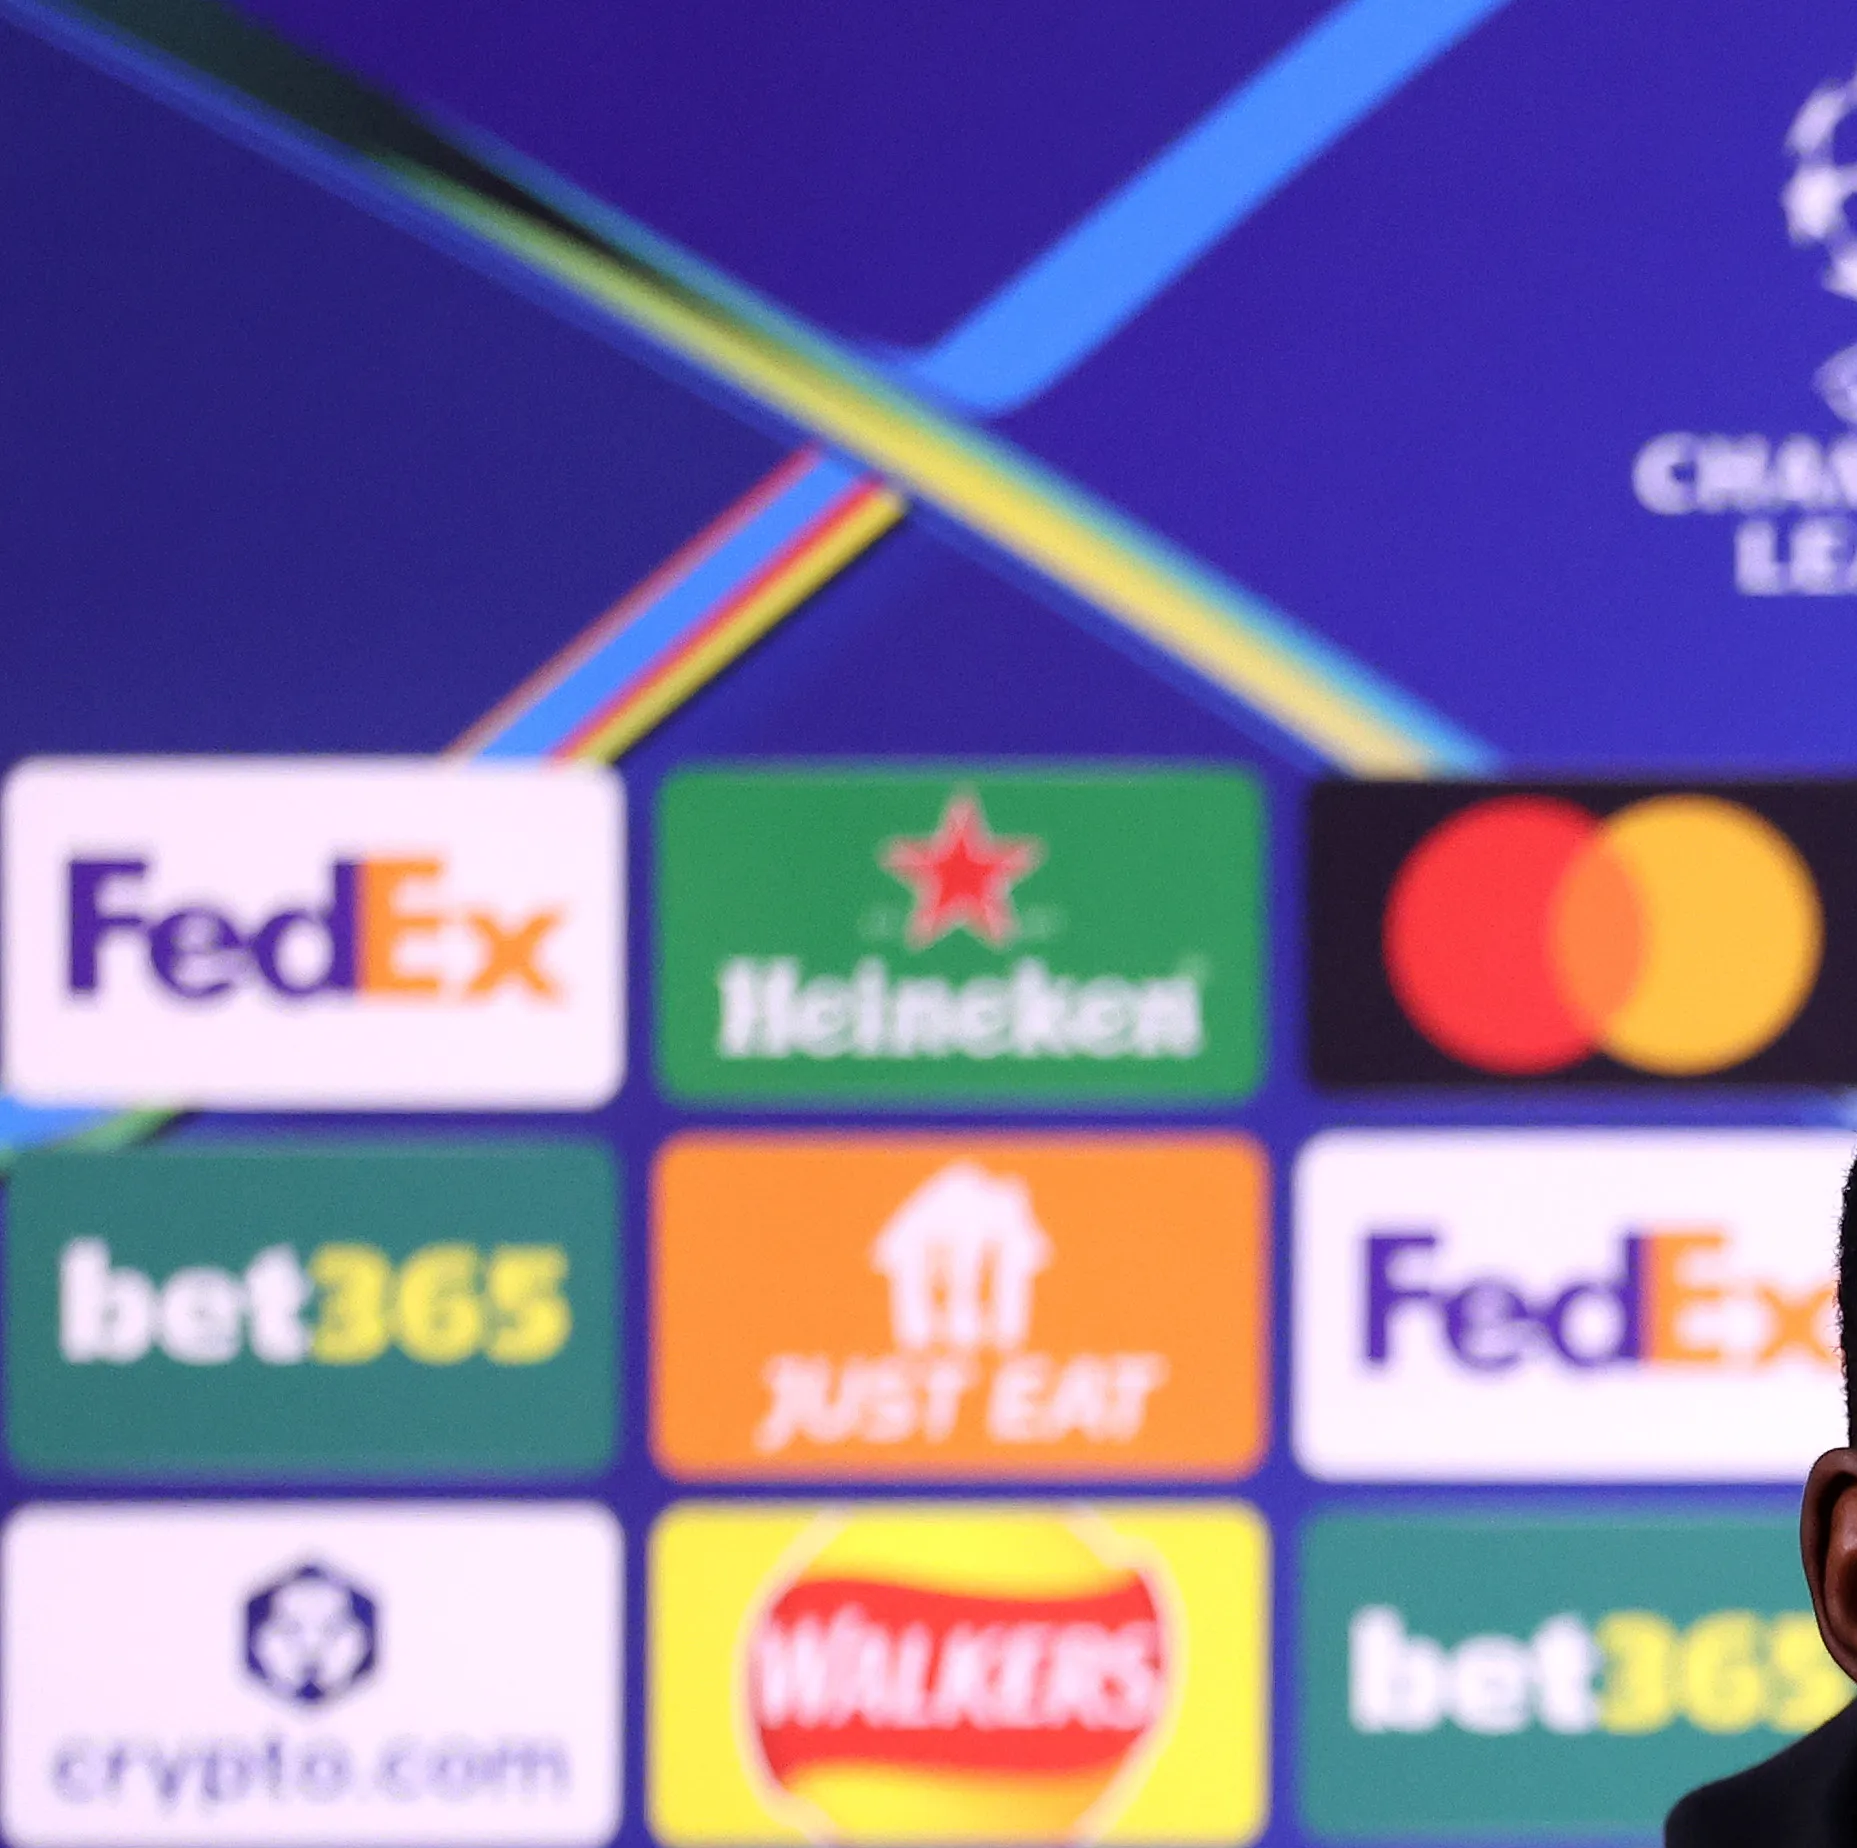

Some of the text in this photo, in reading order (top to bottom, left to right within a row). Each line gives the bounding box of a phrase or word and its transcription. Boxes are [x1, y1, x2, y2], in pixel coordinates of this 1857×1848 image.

[65, 852, 567, 1003] FedEx
[718, 954, 1201, 1059] Heineken
[59, 1238, 572, 1365] bet365
[1362, 1228, 1840, 1372] FedEx
[757, 1355, 1168, 1454] JUST EAT
[762, 1602, 1161, 1731] WALKERS
[51, 1726, 571, 1811] crypto.com
